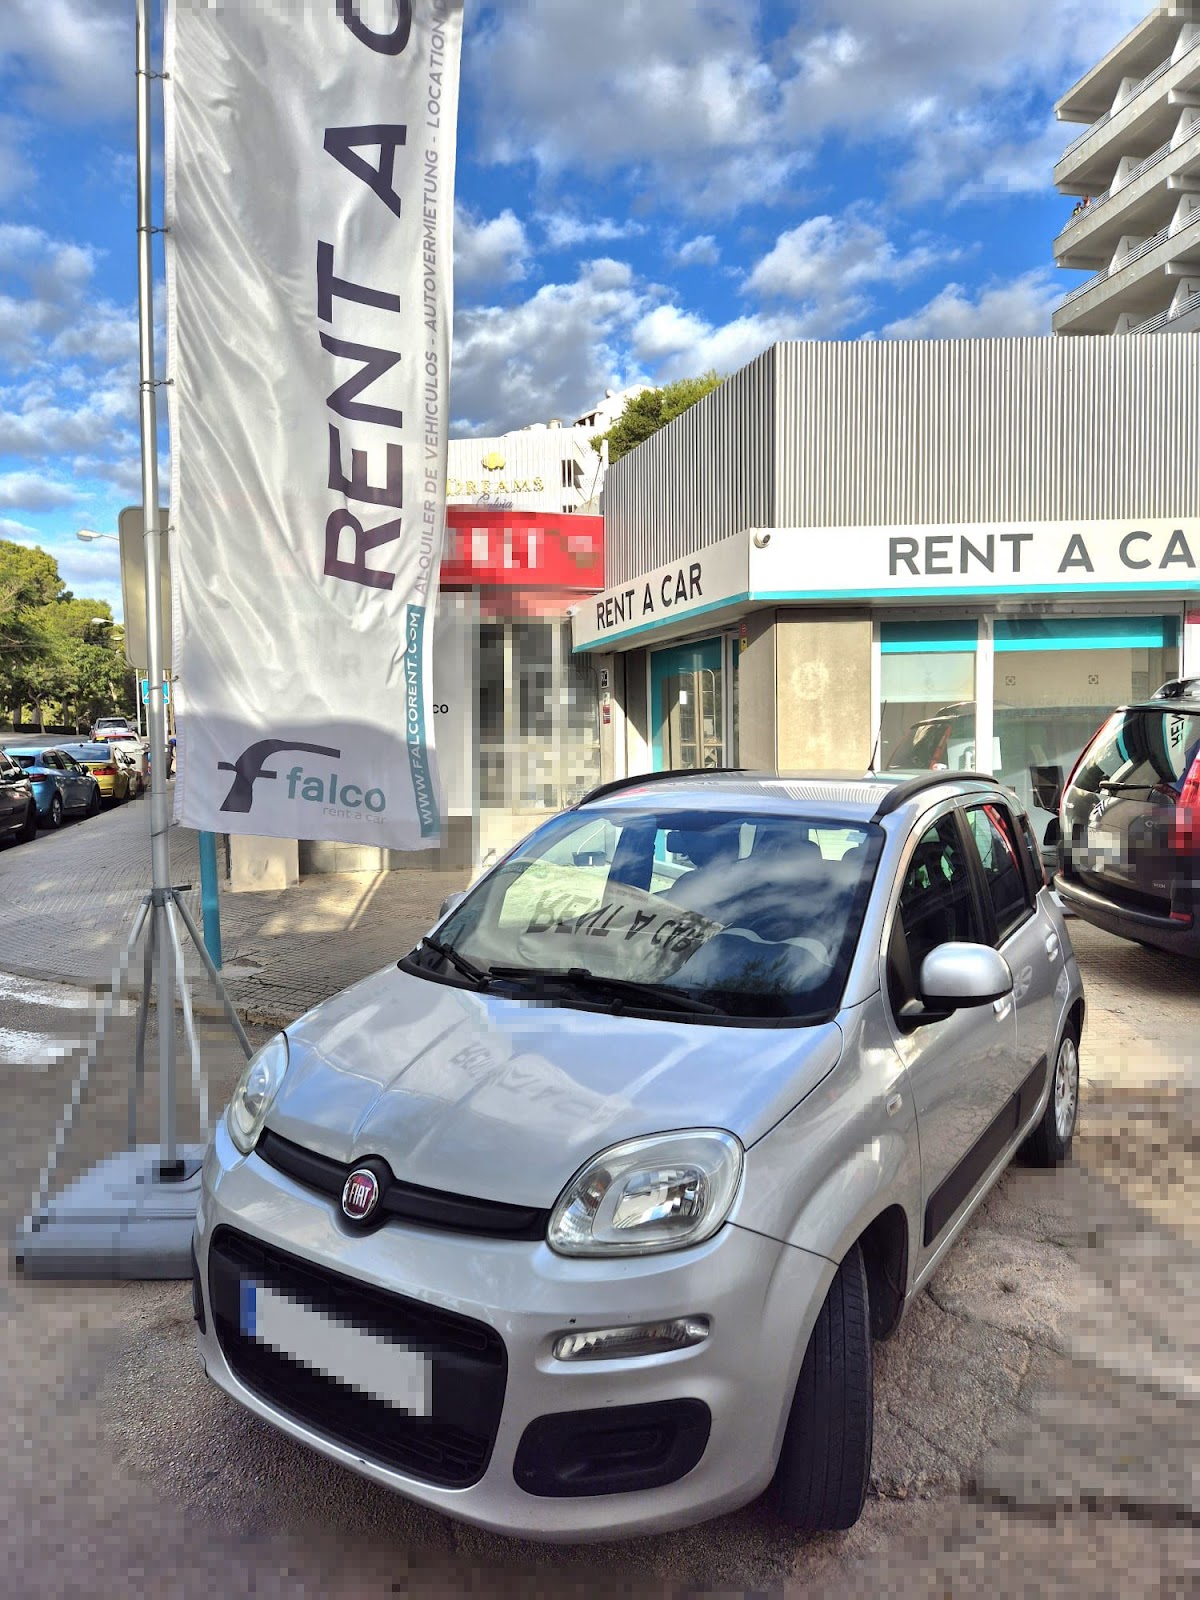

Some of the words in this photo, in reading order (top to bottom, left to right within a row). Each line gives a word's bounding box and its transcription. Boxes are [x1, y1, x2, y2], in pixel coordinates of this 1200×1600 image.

[427, 17, 446, 129] LOCATION
[324, 124, 407, 219] A
[423, 149, 439, 333] AUTOVERMIETUNG
[317, 240, 403, 590] RENT
[424, 351, 439, 461] VEHICULOS
[423, 470, 438, 495] DE
[414, 501, 436, 595] ALQUILER
[888, 533, 1034, 576] RENT
[1057, 533, 1095, 573] A
[596, 588, 635, 631] RENT
[642, 582, 655, 616] A
[661, 562, 703, 608] CAR
[286, 766, 386, 813] falco
[322, 806, 351, 820] rent
[355, 811, 362, 820] a
[365, 814, 387, 825] car
[348, 1183, 371, 1208] FIAT
